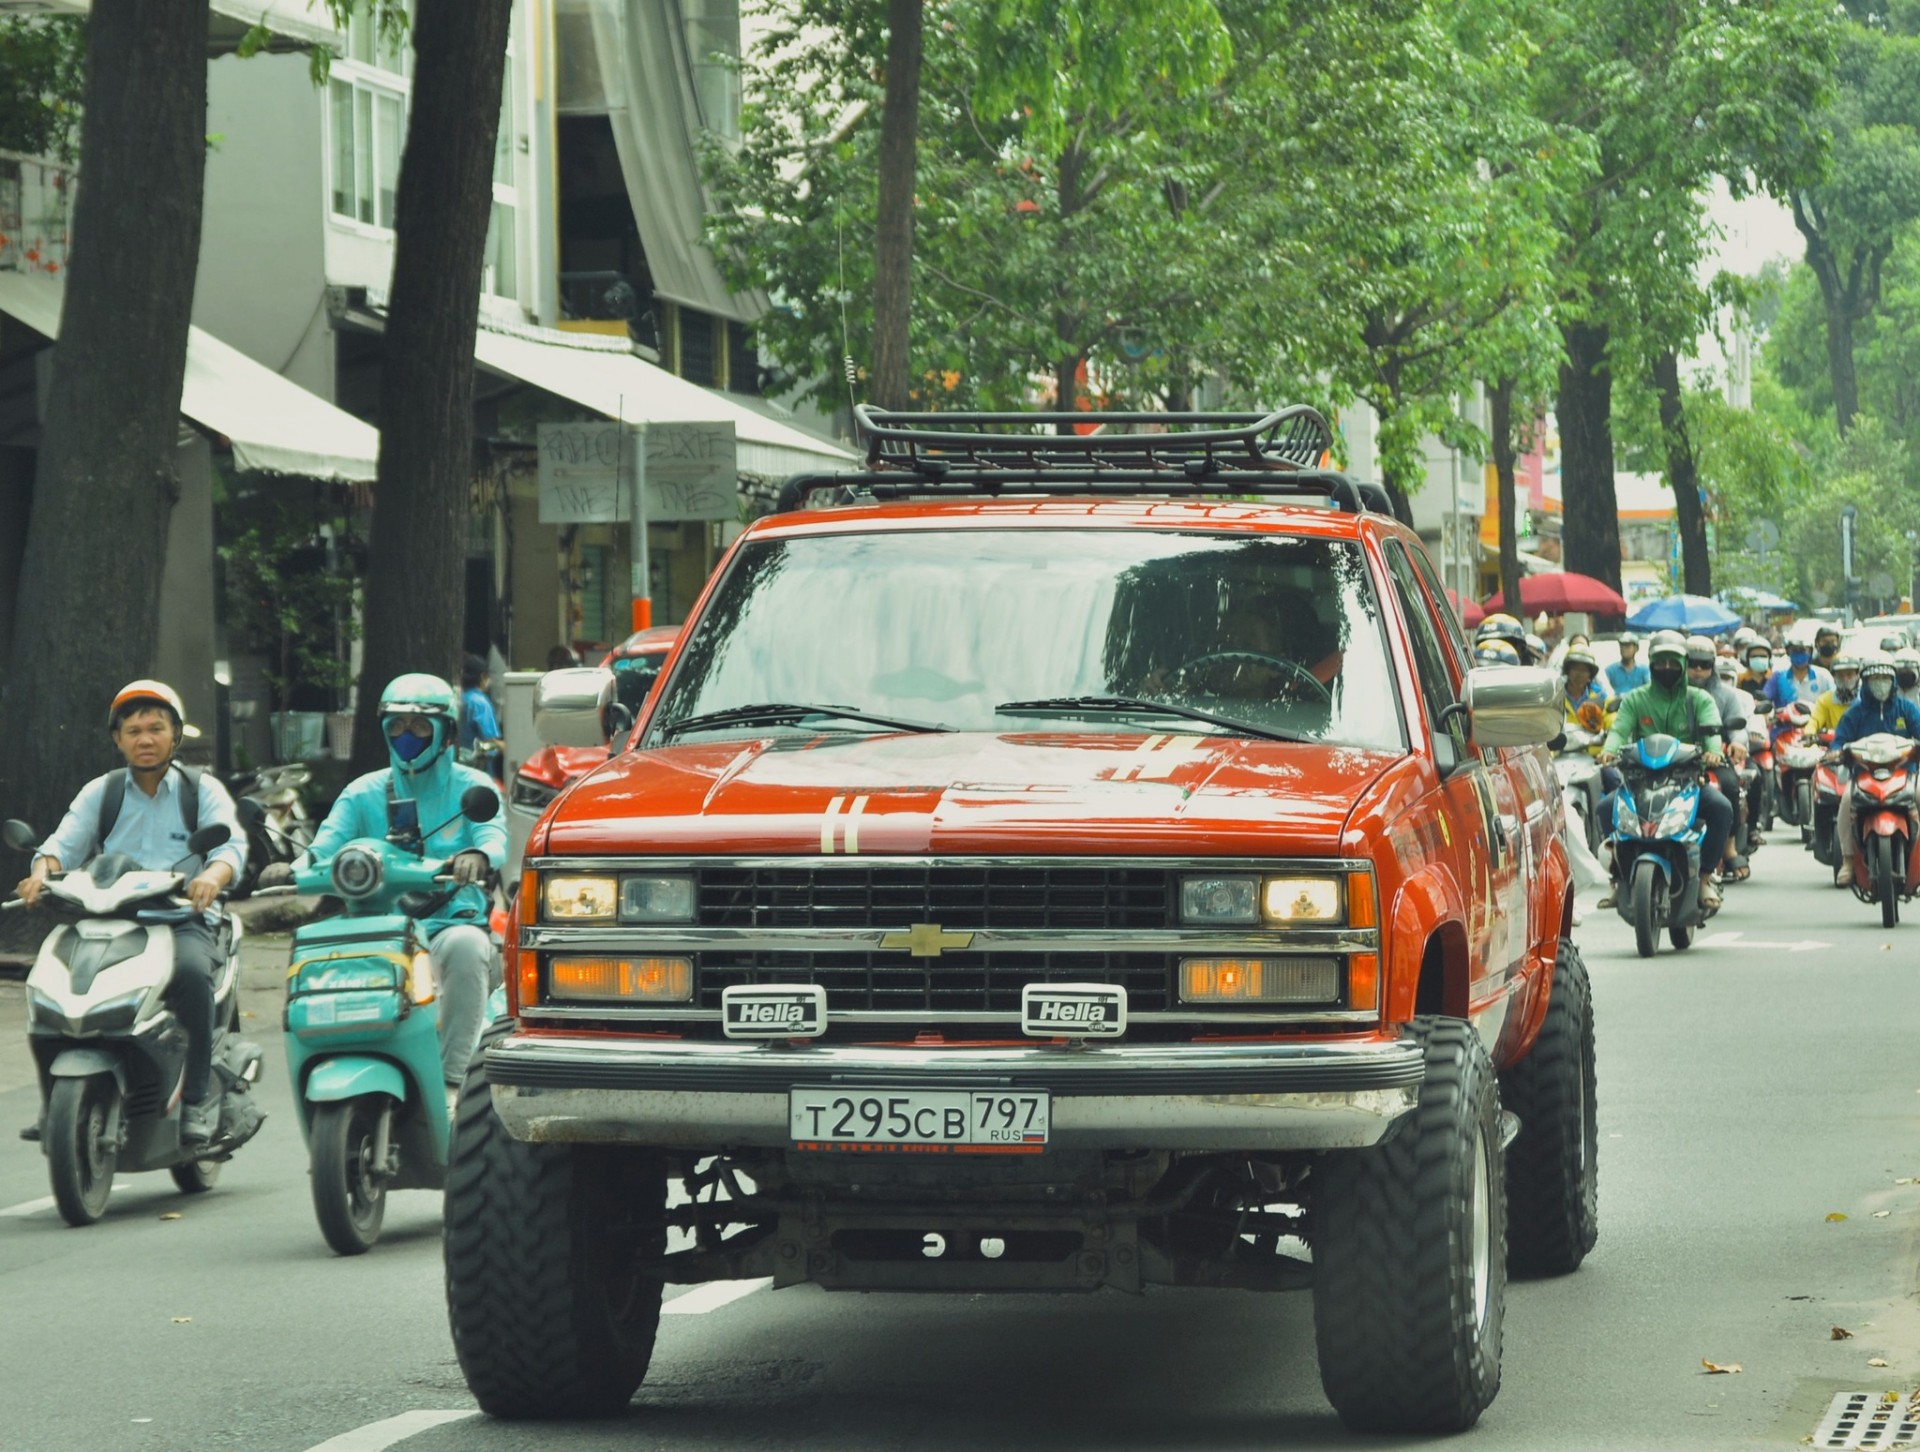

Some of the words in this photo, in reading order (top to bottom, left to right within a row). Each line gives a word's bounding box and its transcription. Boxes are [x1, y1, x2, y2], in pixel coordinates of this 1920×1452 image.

[739, 1003, 805, 1023] Hella
[1039, 1001, 1106, 1022] Hella
[976, 1097, 1038, 1129] 797
[990, 1129, 1022, 1141] RUS
